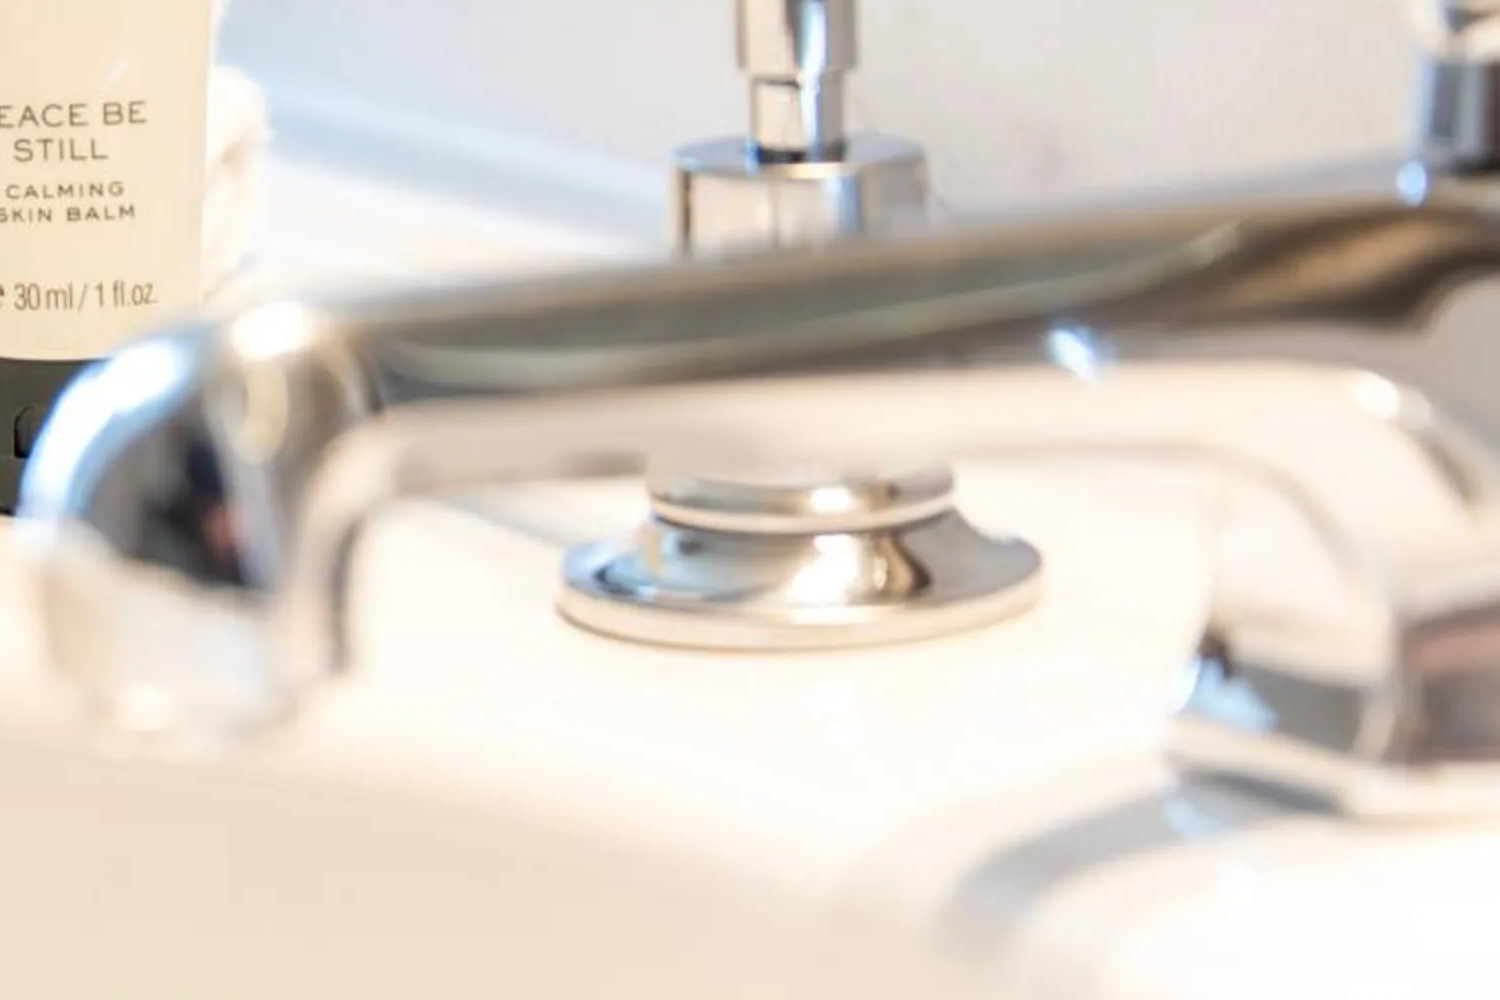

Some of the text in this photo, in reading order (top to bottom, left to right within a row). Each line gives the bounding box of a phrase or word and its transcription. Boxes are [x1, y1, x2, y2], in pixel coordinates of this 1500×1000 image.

[103, 101, 147, 125] BE
[13, 137, 109, 162] STILL
[5, 181, 124, 199] CALMING
[67, 204, 135, 222] BALM
